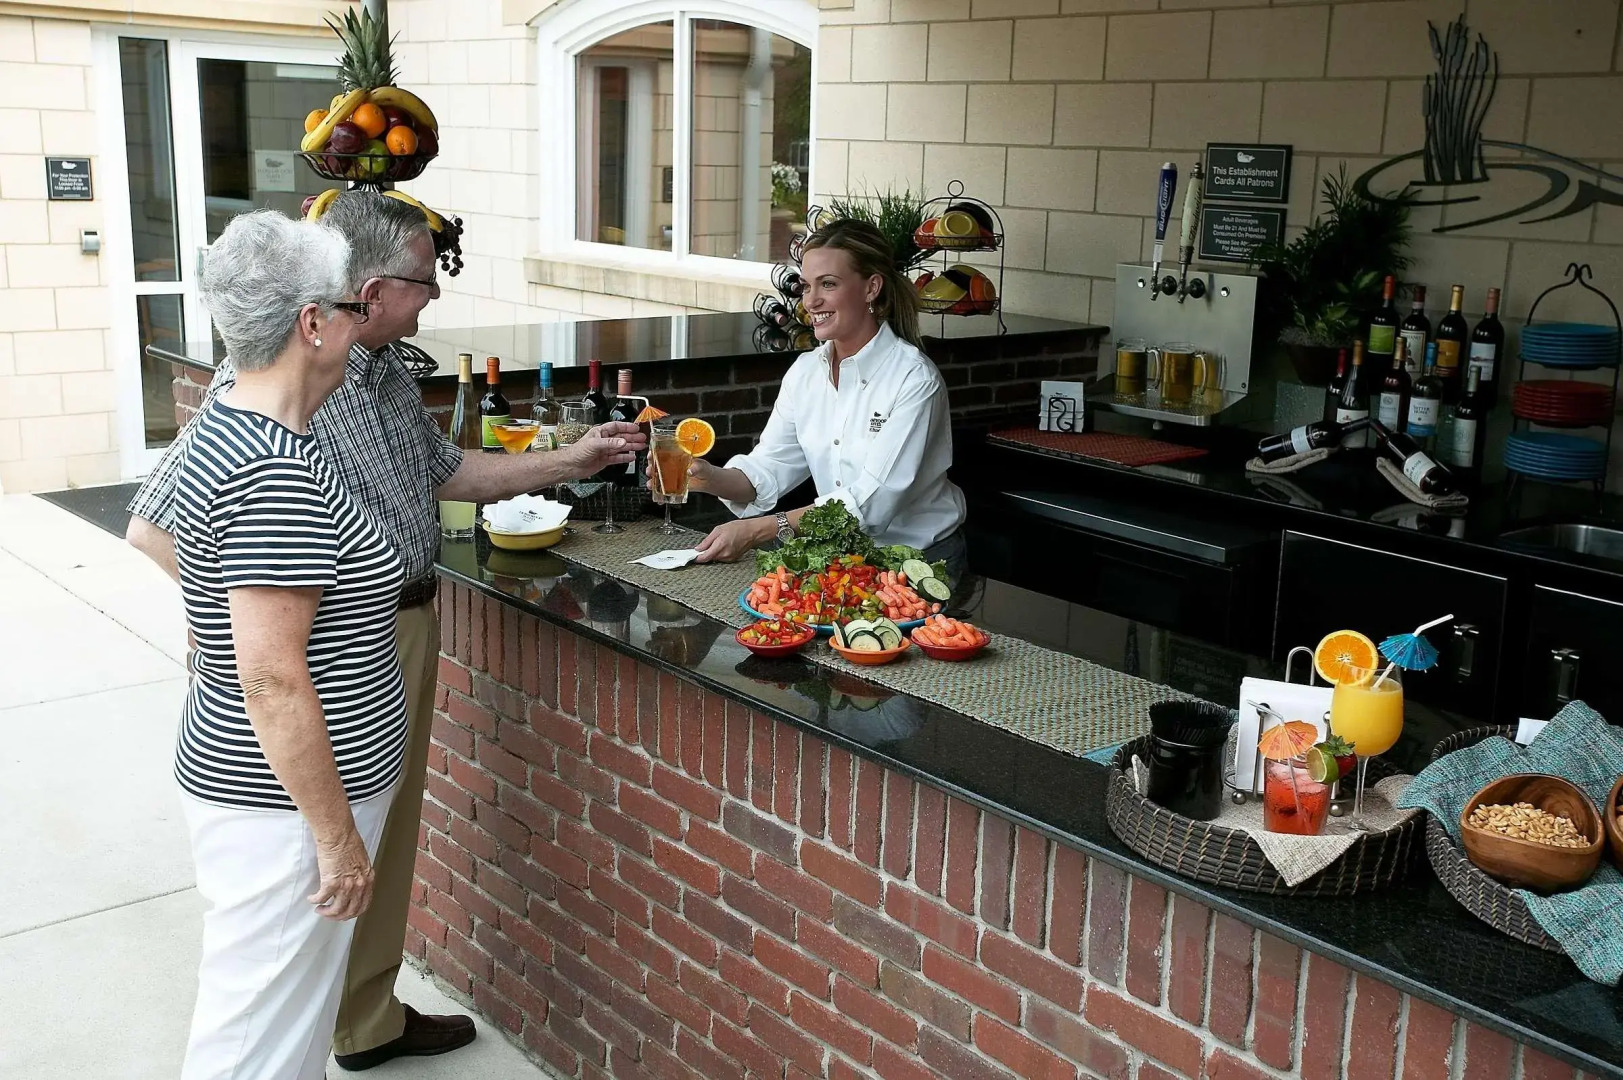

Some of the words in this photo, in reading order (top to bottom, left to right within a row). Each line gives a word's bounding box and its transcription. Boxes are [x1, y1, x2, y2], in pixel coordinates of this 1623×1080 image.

[1213, 166, 1227, 175] This
[1228, 167, 1278, 177] Establishment
[1214, 176, 1235, 186] Cards
[1236, 178, 1246, 186] All
[1247, 178, 1275, 188] Patrons
[1161, 179, 1170, 208] LIGHT
[1158, 210, 1167, 232] BUD
